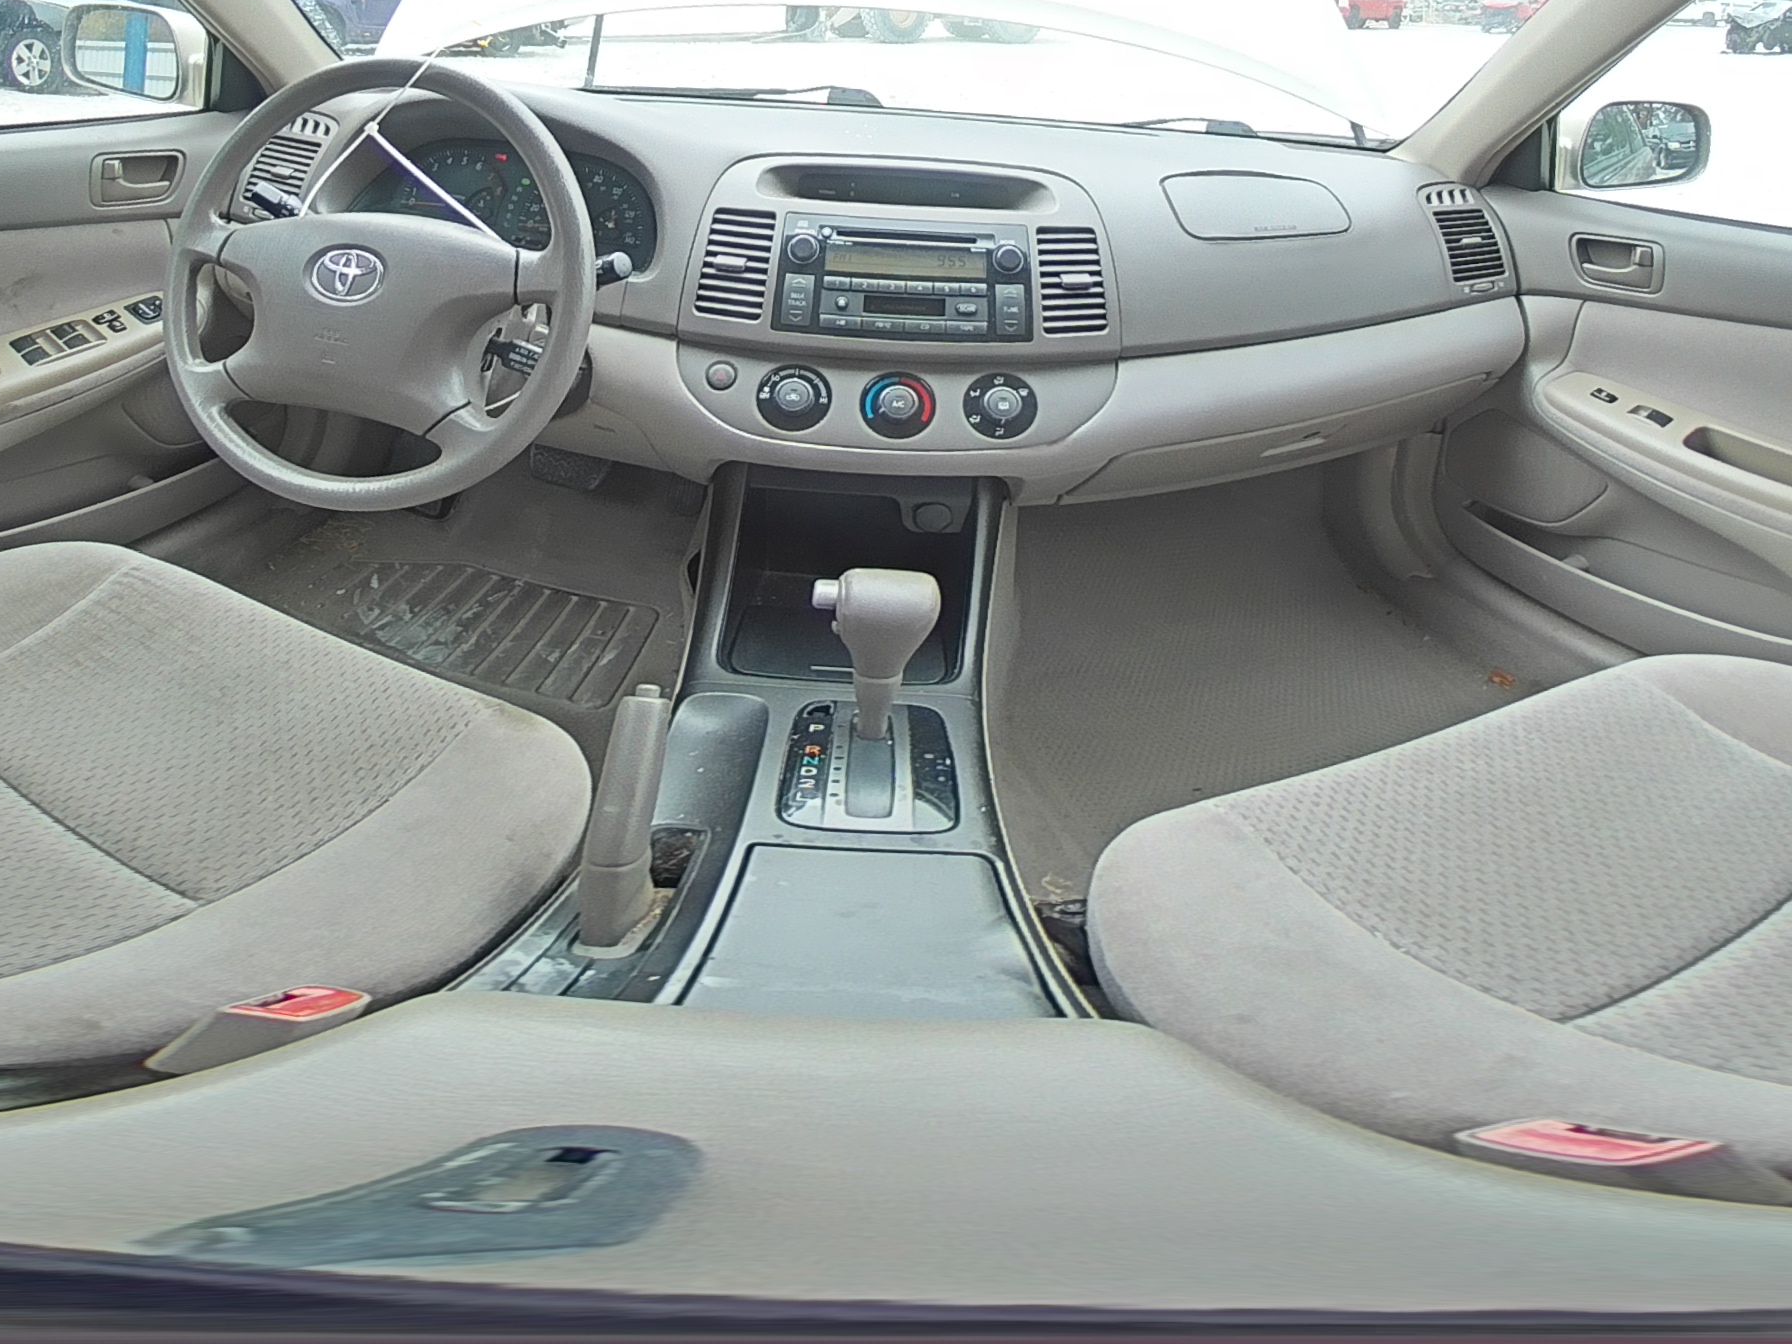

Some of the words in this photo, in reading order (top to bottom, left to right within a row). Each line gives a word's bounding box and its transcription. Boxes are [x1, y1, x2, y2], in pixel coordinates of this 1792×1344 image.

[808, 723, 825, 733] P
[804, 745, 822, 755] R
[802, 756, 820, 765] N
[800, 766, 818, 776] D
